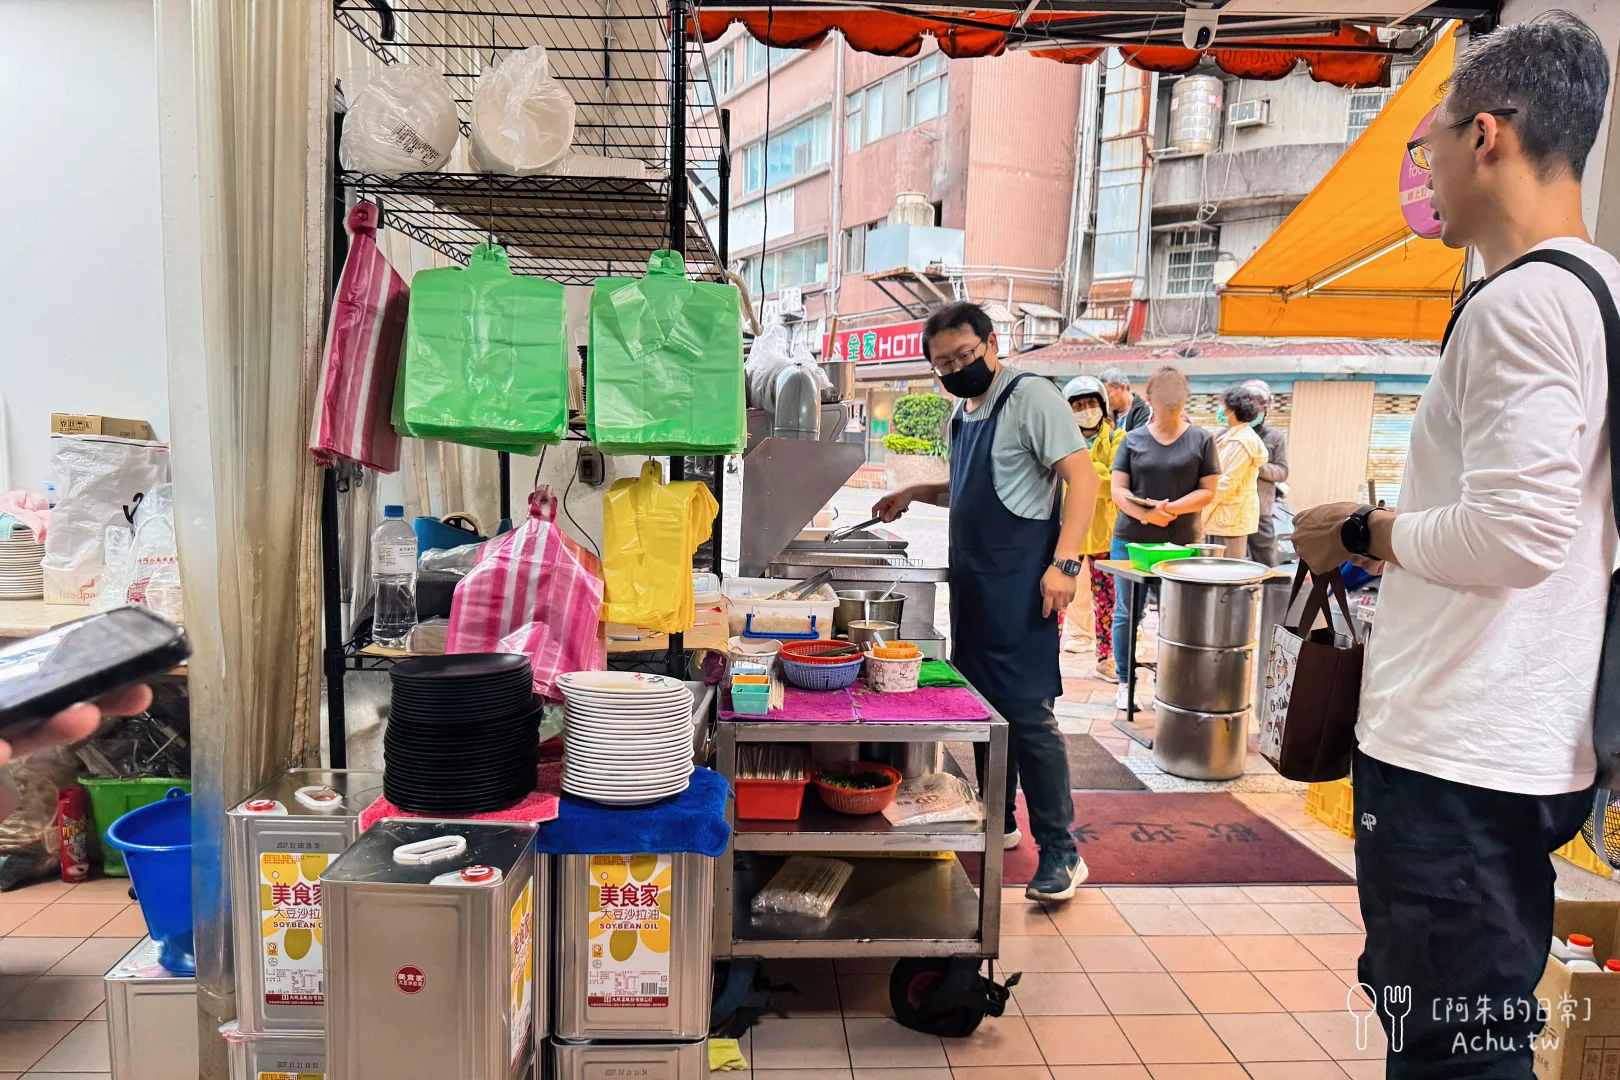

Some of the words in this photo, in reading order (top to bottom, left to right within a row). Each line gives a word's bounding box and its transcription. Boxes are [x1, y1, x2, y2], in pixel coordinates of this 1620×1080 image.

[847, 331, 877, 361] 全家
[600, 882, 660, 907] 美食家
[600, 909, 660, 920] 大豆沙拉油
[599, 922, 642, 930] SOYBEAN
